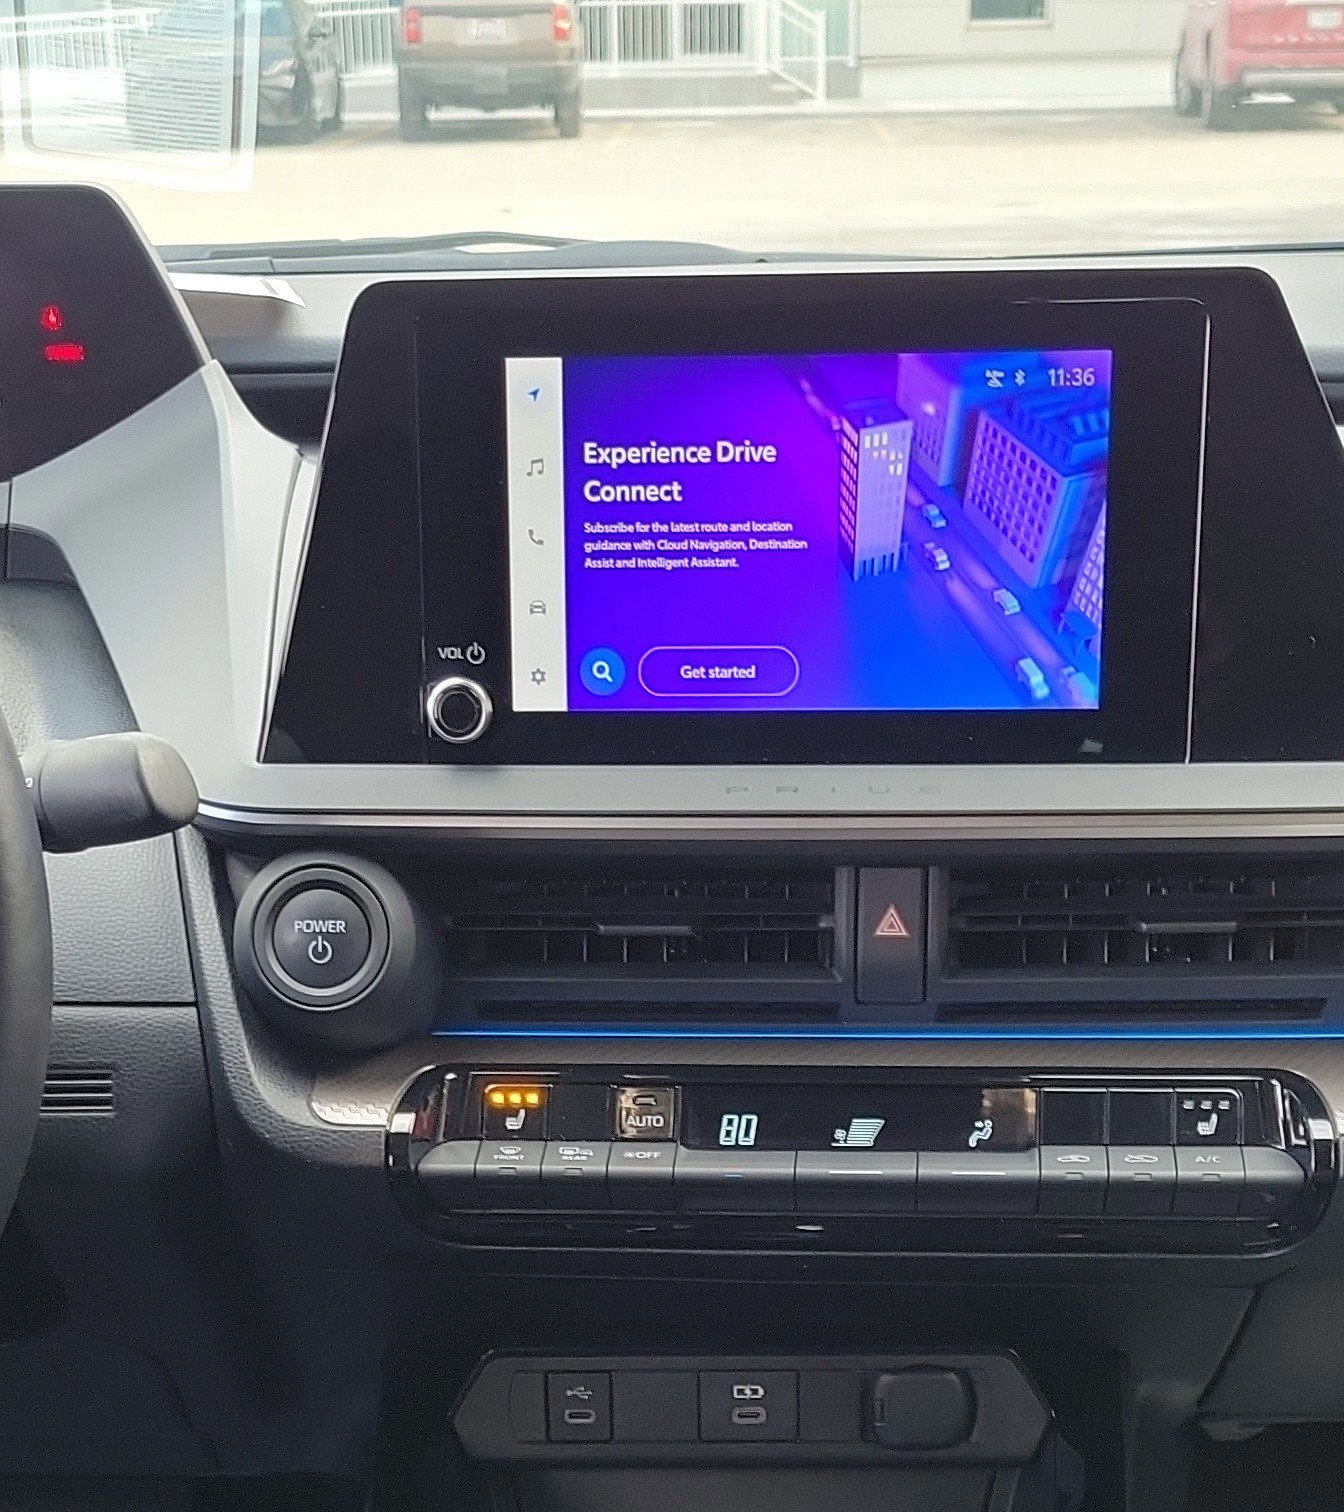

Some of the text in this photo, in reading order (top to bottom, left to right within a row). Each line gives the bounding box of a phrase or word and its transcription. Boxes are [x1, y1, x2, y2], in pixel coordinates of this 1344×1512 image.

[1048, 368, 1095, 386] 11:36
[583, 440, 777, 469] Experience Drive
[583, 479, 683, 502] Connect
[584, 521, 793, 533] Subscribe for the latest route and location
[584, 538, 808, 553] guidance with Cloud Navigation, Destination
[584, 556, 739, 570] Assist and Intelligent Assistant.
[437, 646, 464, 659] VOL
[680, 664, 756, 679] Get started
[294, 920, 346, 933] POWER
[628, 1115, 665, 1128] AUTO
[719, 1114, 759, 1145] 80
[636, 1152, 661, 1160] OFF
[1195, 1155, 1221, 1163] A/C
